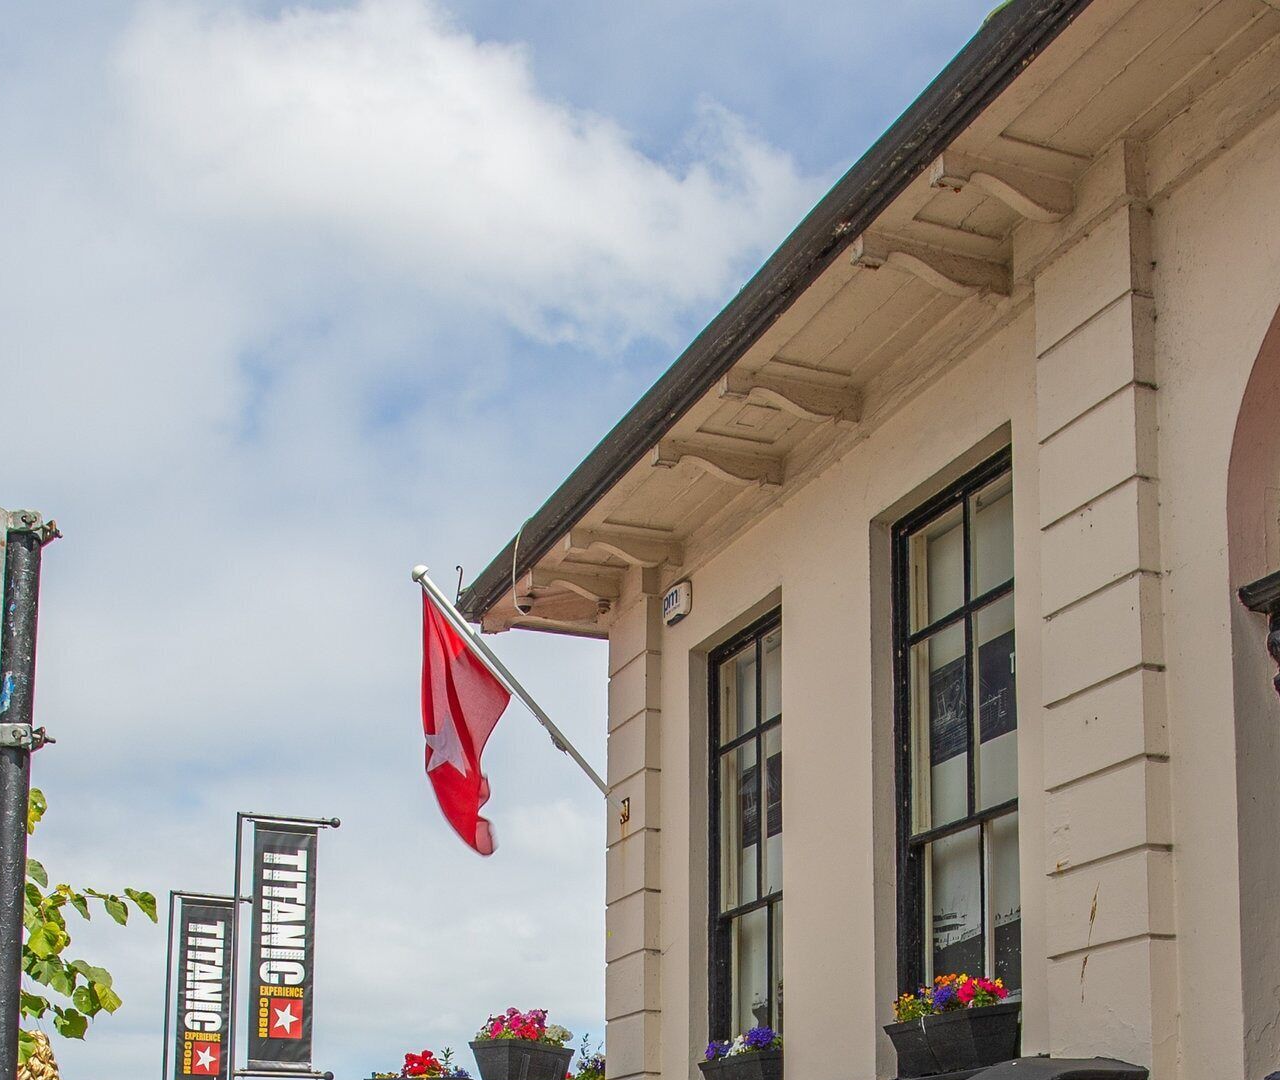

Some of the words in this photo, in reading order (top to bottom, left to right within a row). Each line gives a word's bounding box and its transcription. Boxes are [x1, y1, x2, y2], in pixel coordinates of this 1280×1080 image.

[259, 850, 308, 985] TITANIC
[184, 920, 225, 1032] TITANIC
[260, 985, 304, 998] EXPERIENCE
[184, 1031, 221, 1042] EXPERIENCE
[258, 997, 269, 1039] COBH
[183, 1040, 193, 1075] COBH
